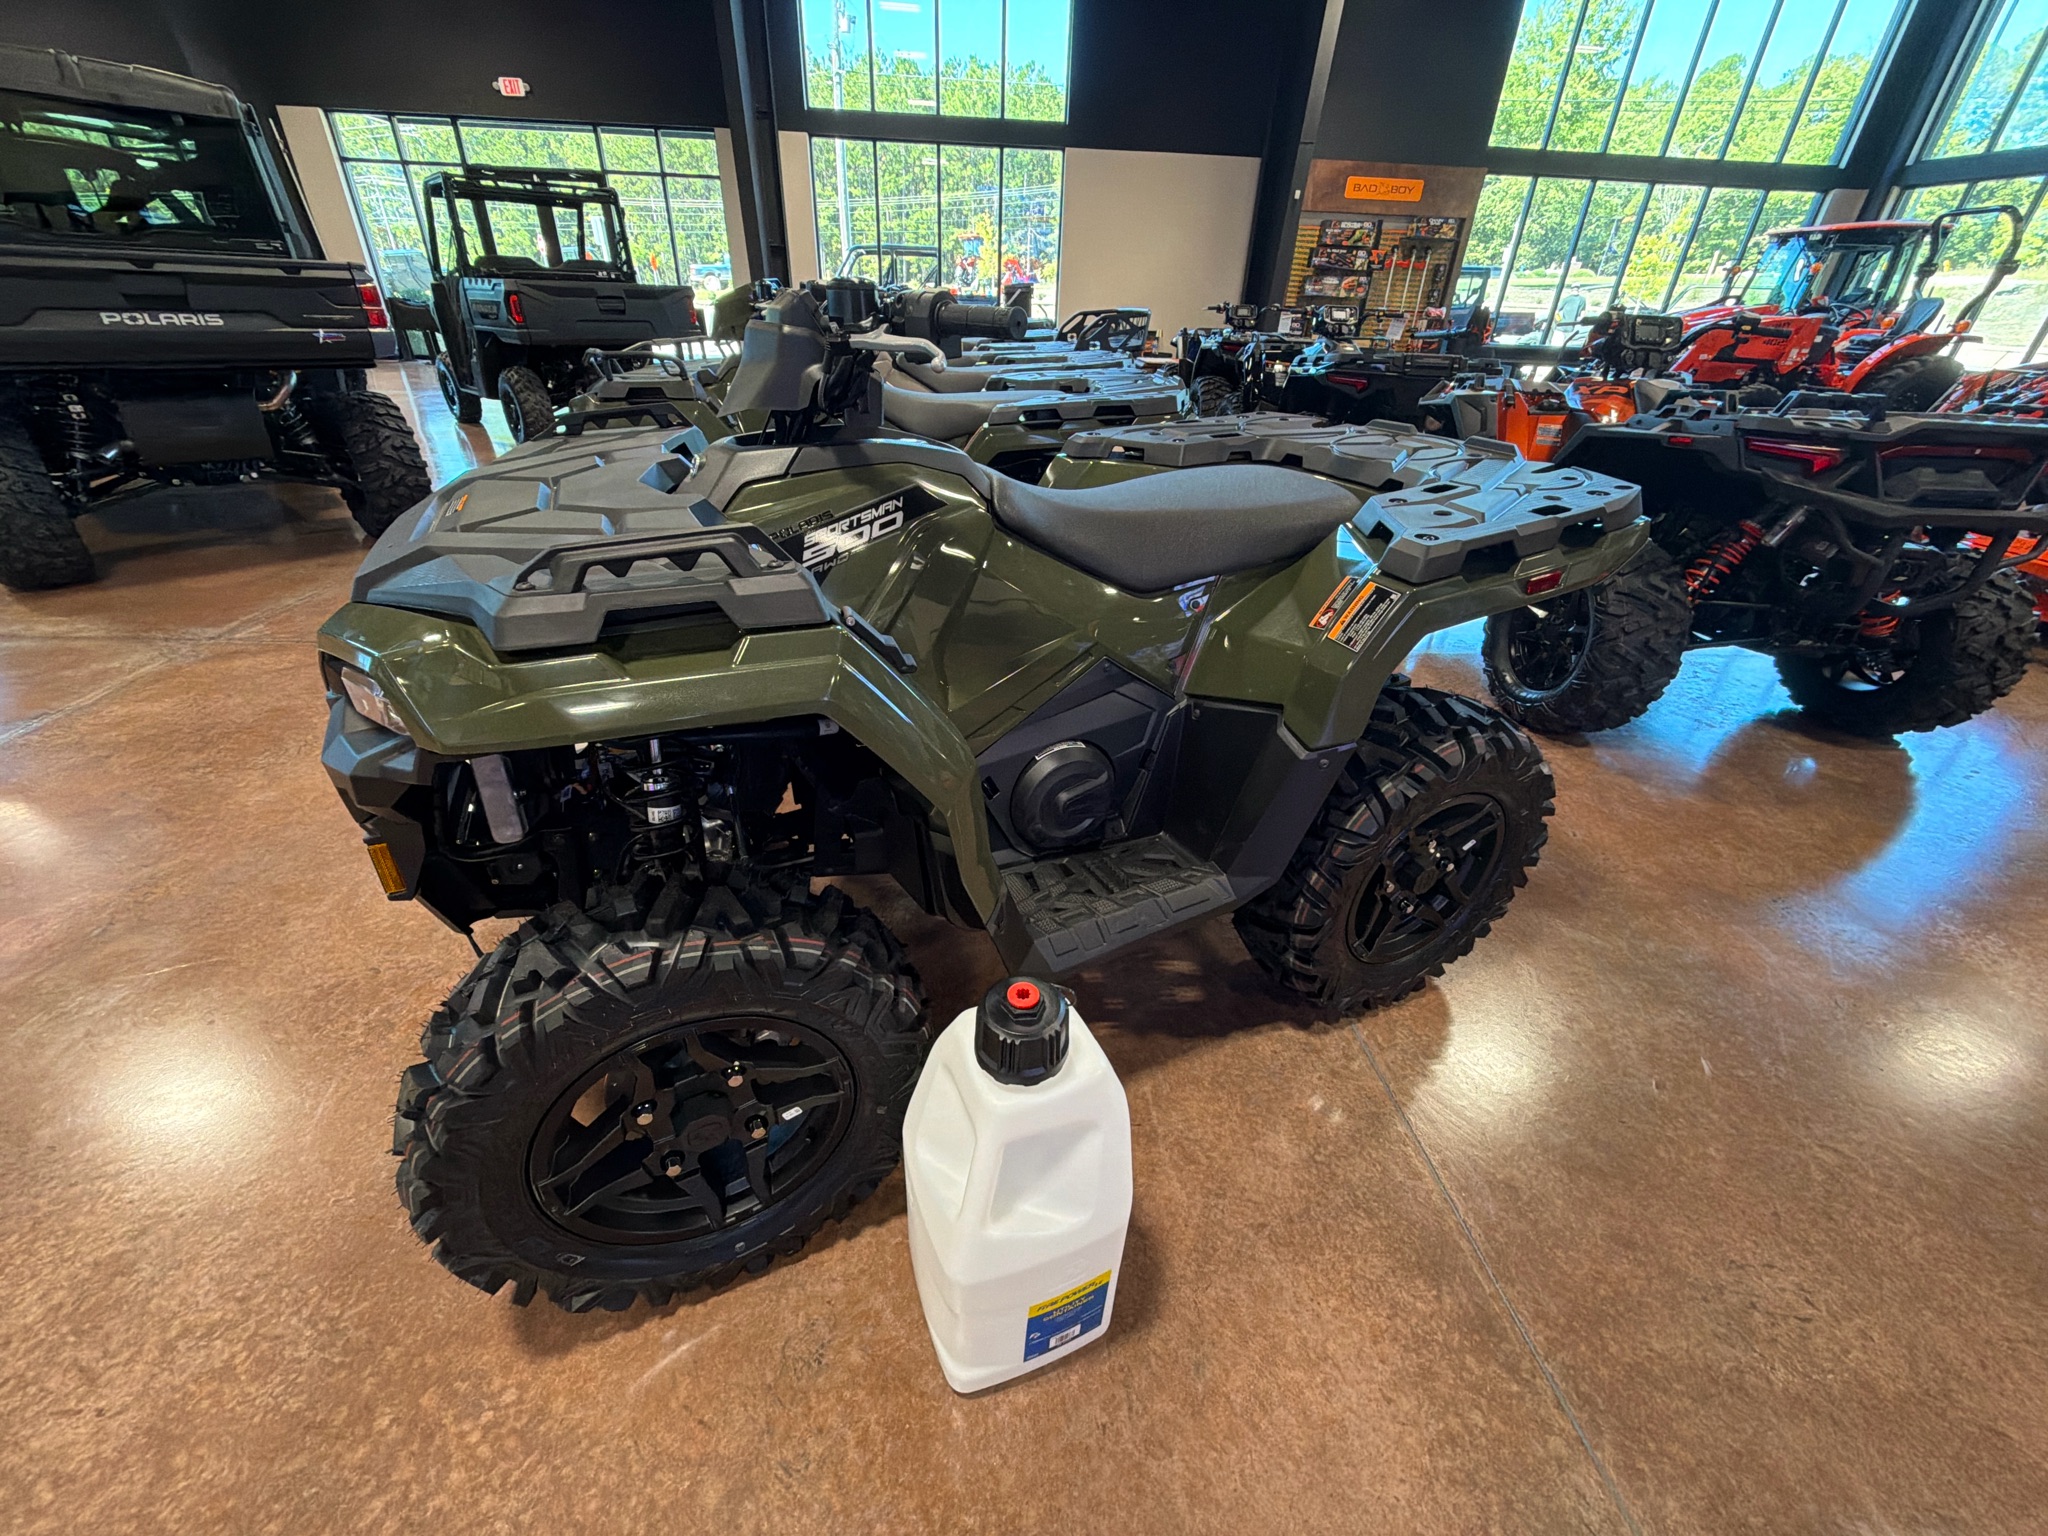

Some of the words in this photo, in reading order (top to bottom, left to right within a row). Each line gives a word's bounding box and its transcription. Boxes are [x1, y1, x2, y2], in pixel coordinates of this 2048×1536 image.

[502, 79, 521, 95] EXIT
[1353, 183, 1378, 193] BAD
[1390, 185, 1415, 195] BOY
[99, 311, 225, 327] POLARIS
[768, 509, 835, 540] POLARIS
[803, 496, 904, 548] SPORTSMAN
[811, 552, 849, 574] AWD
[1343, 595, 1365, 620] WARNING
